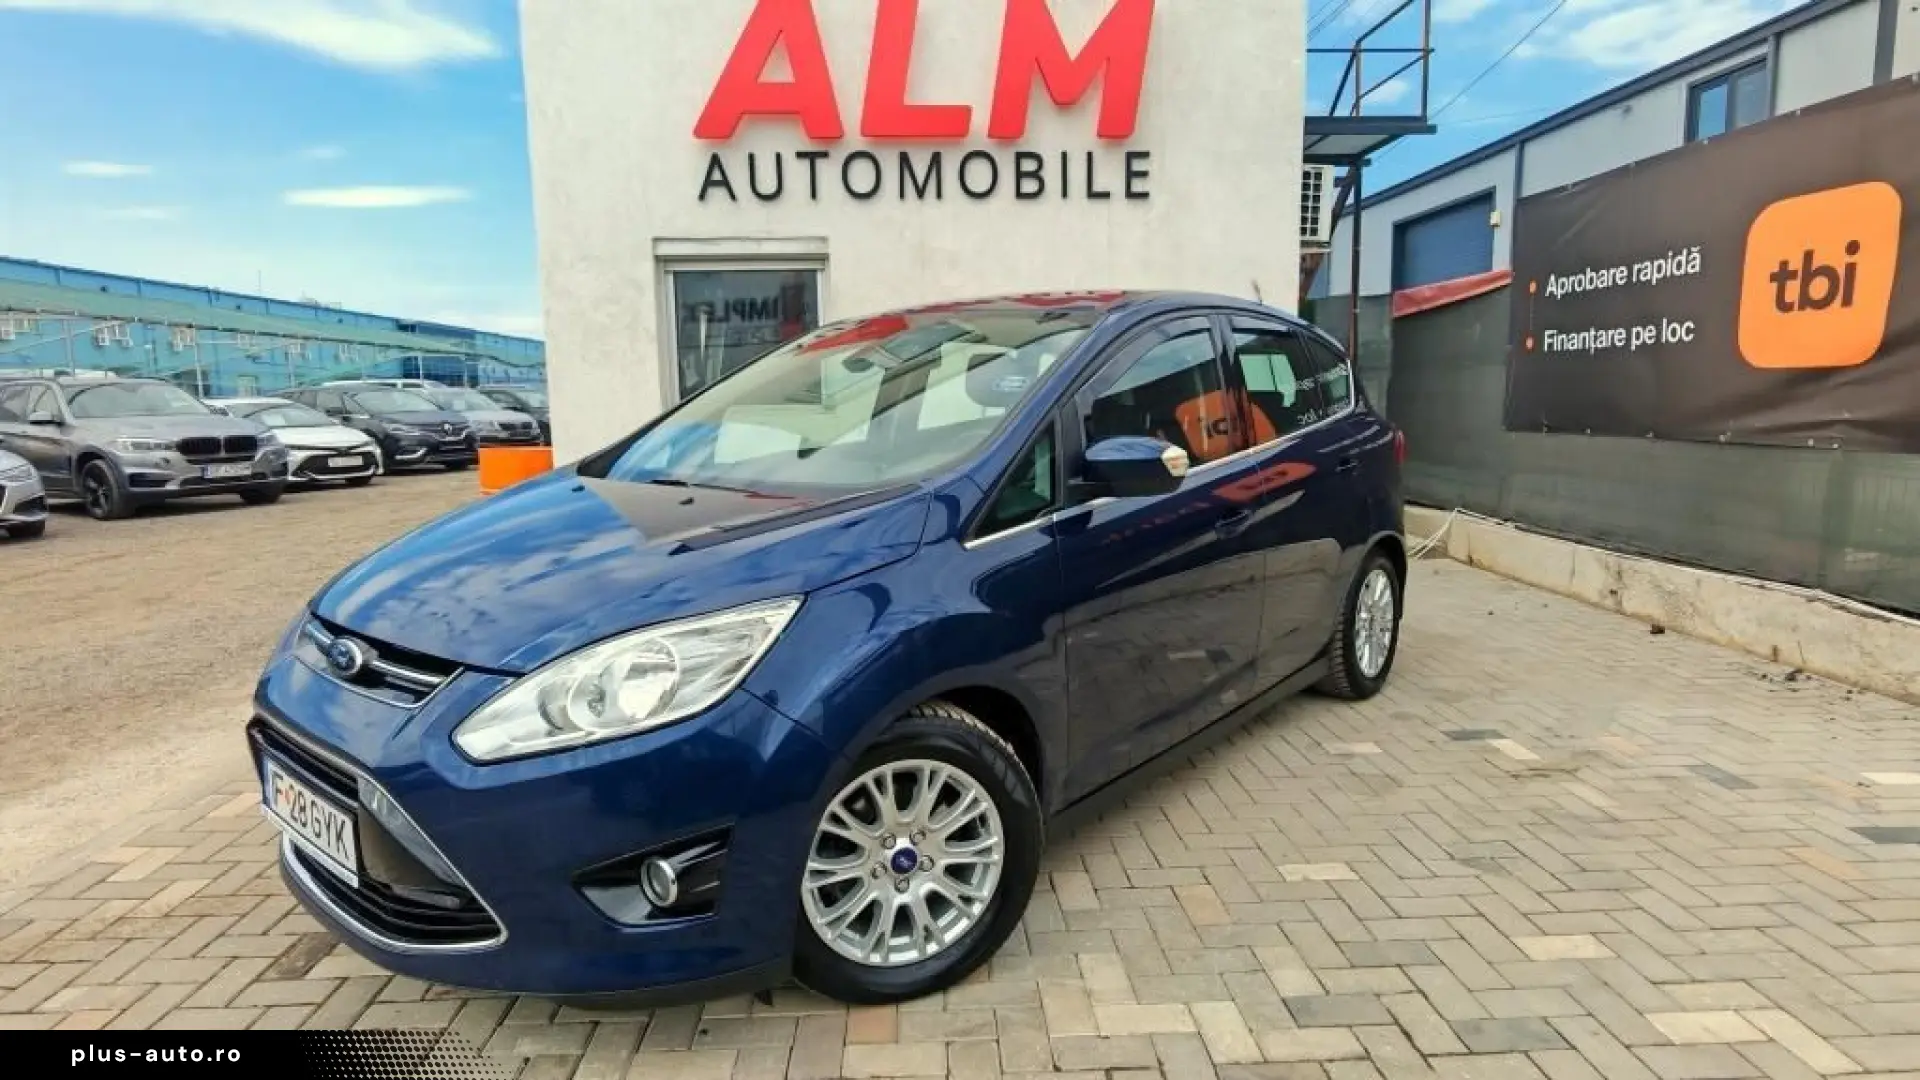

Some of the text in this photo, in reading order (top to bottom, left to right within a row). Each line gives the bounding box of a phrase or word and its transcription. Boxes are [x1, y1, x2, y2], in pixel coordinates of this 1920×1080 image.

[693, 0, 1156, 139] ALM
[699, 150, 1150, 201] AUTOMOBILE
[1545, 246, 1702, 300] Aprobare rapidă
[1769, 239, 1861, 313] tbi
[1543, 317, 1696, 355] Finanțare pe loc
